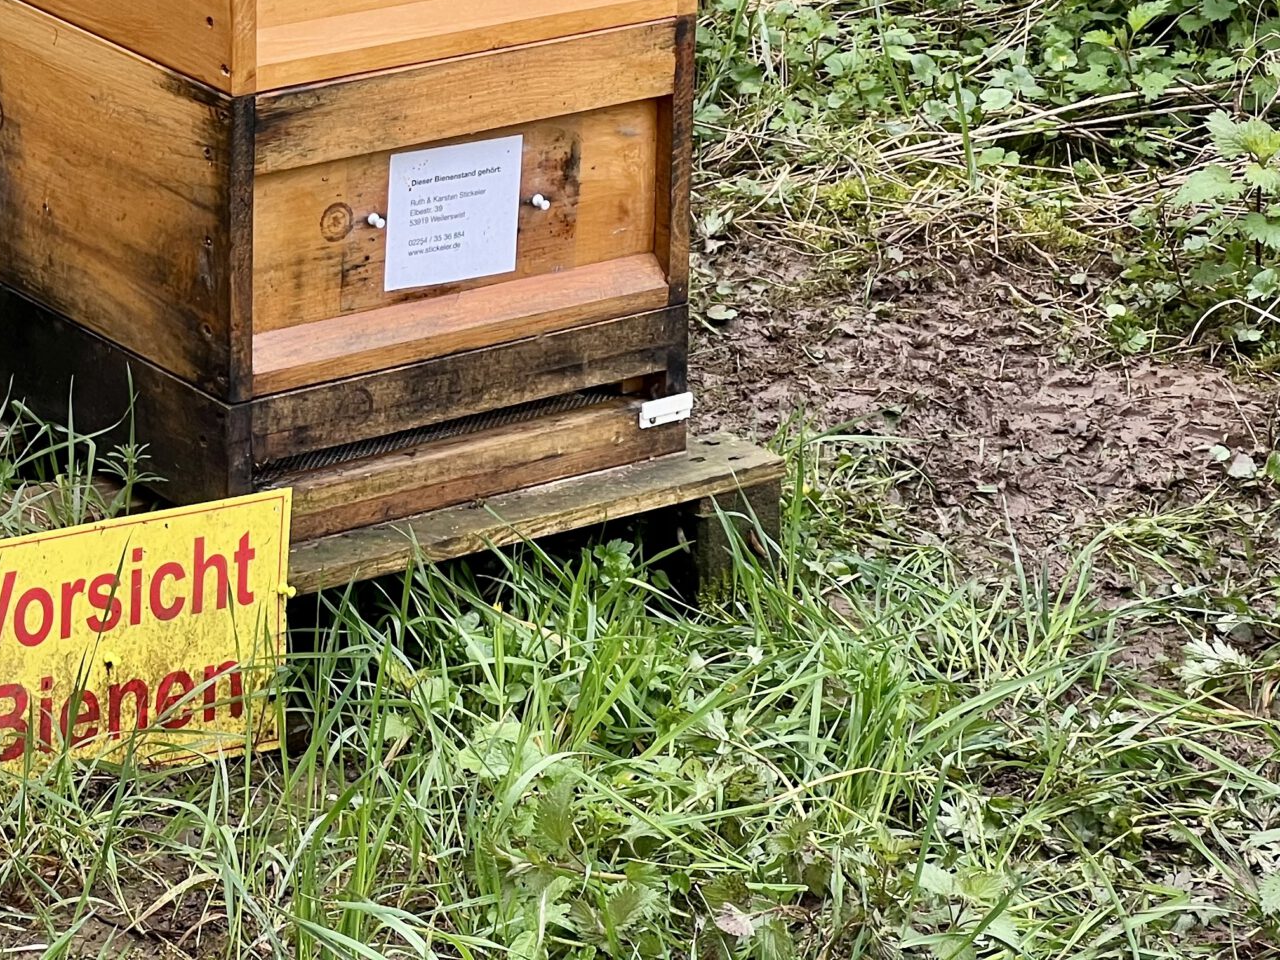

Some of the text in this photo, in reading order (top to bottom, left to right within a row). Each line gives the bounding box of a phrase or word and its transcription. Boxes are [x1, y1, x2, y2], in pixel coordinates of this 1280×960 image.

[411, 177, 432, 187] Dieser
[434, 170, 477, 183] Bienenstand
[426, 196, 431, 204] &
[433, 194, 458, 203] Karsten
[434, 204, 443, 213] 39
[408, 237, 427, 246] 02254
[408, 242, 461, 256] www.stickeler.de
